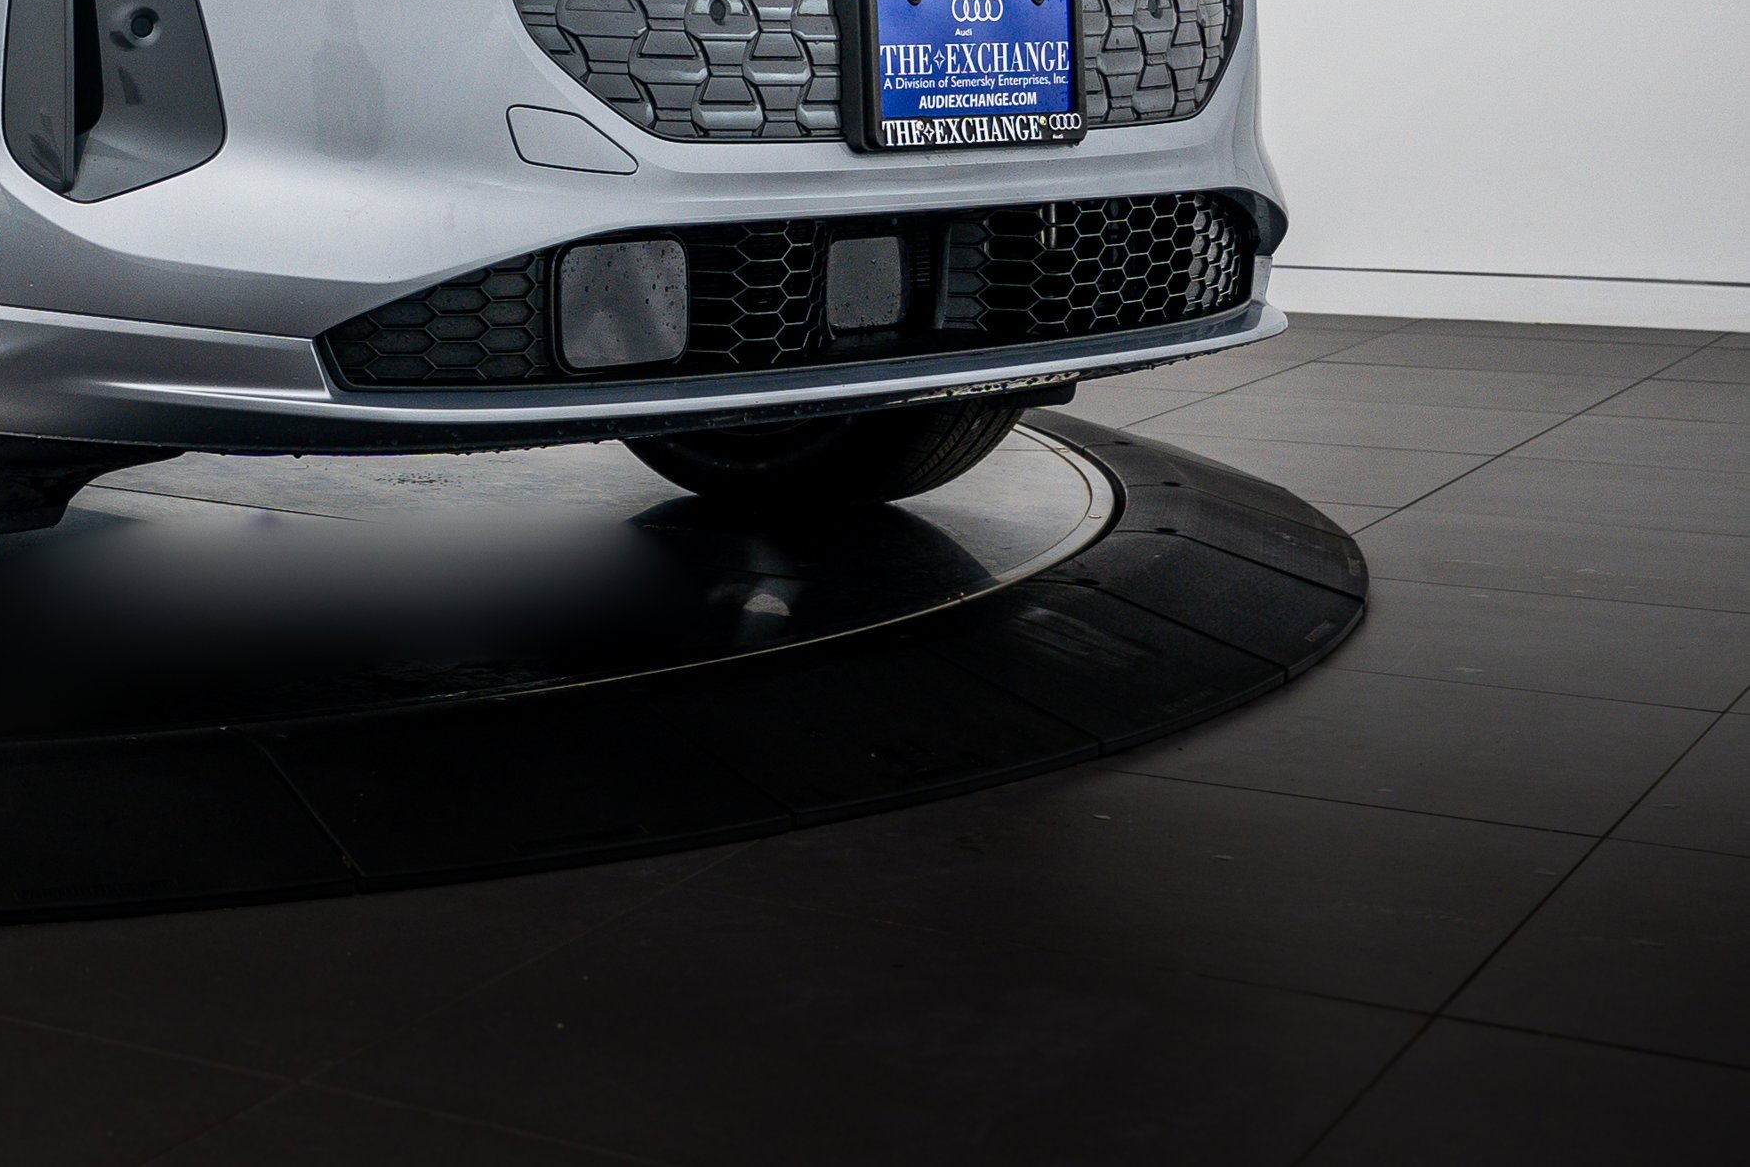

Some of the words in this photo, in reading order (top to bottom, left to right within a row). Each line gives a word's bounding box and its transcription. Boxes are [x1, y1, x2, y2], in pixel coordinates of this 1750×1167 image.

[954, 28, 973, 37] Audi
[879, 44, 933, 76] THE
[944, 40, 1070, 74] EXCHANGE
[883, 77, 893, 90] A
[895, 77, 936, 90] Division
[938, 75, 950, 88] of
[950, 74, 996, 90] Semersky
[998, 74, 1051, 89] Enterprises,
[1053, 72, 1069, 84] Inc.
[918, 91, 1038, 110] AUDIEXCHANGE.COM
[881, 119, 925, 146] THE
[932, 114, 1043, 145] EXCHANGE
